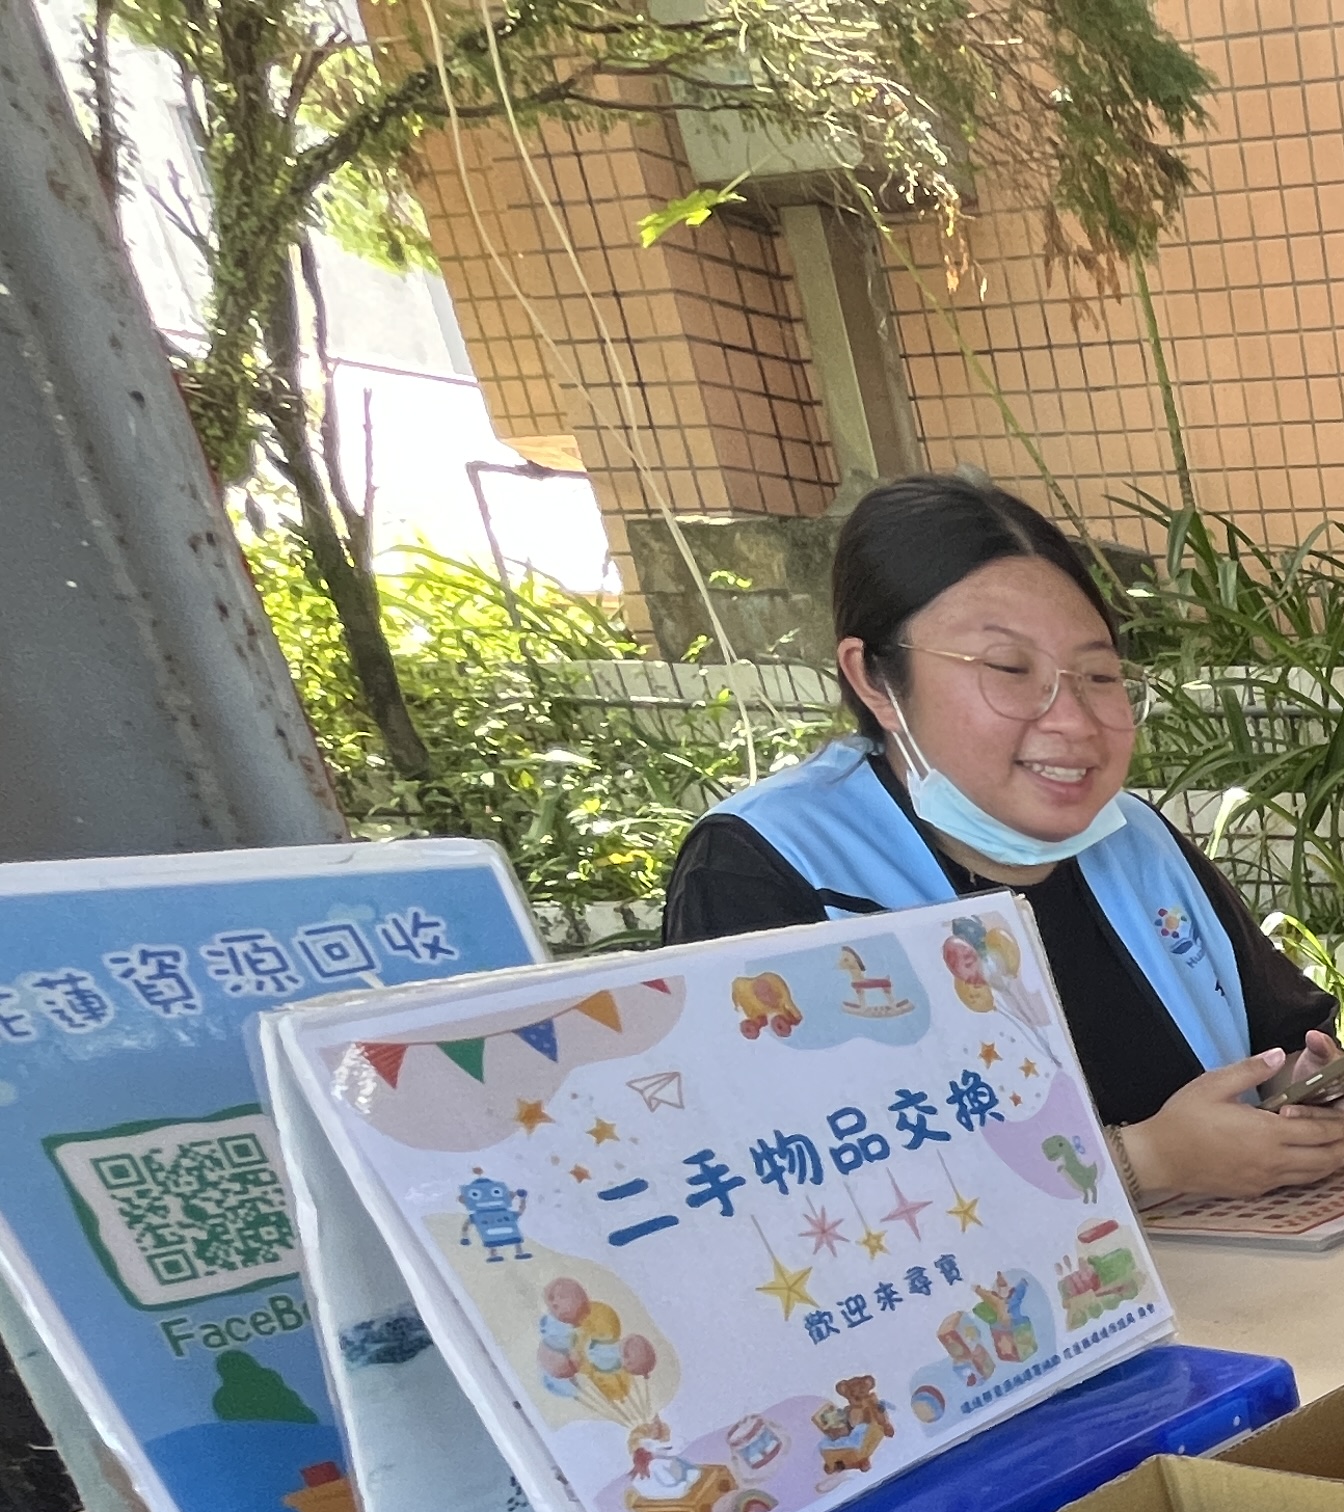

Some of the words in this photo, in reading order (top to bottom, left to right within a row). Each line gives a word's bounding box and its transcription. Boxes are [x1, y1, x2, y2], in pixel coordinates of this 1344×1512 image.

[598, 1069, 1006, 1247] 二手物品交換
[803, 1253, 966, 1345] 歡迎來尋寶
